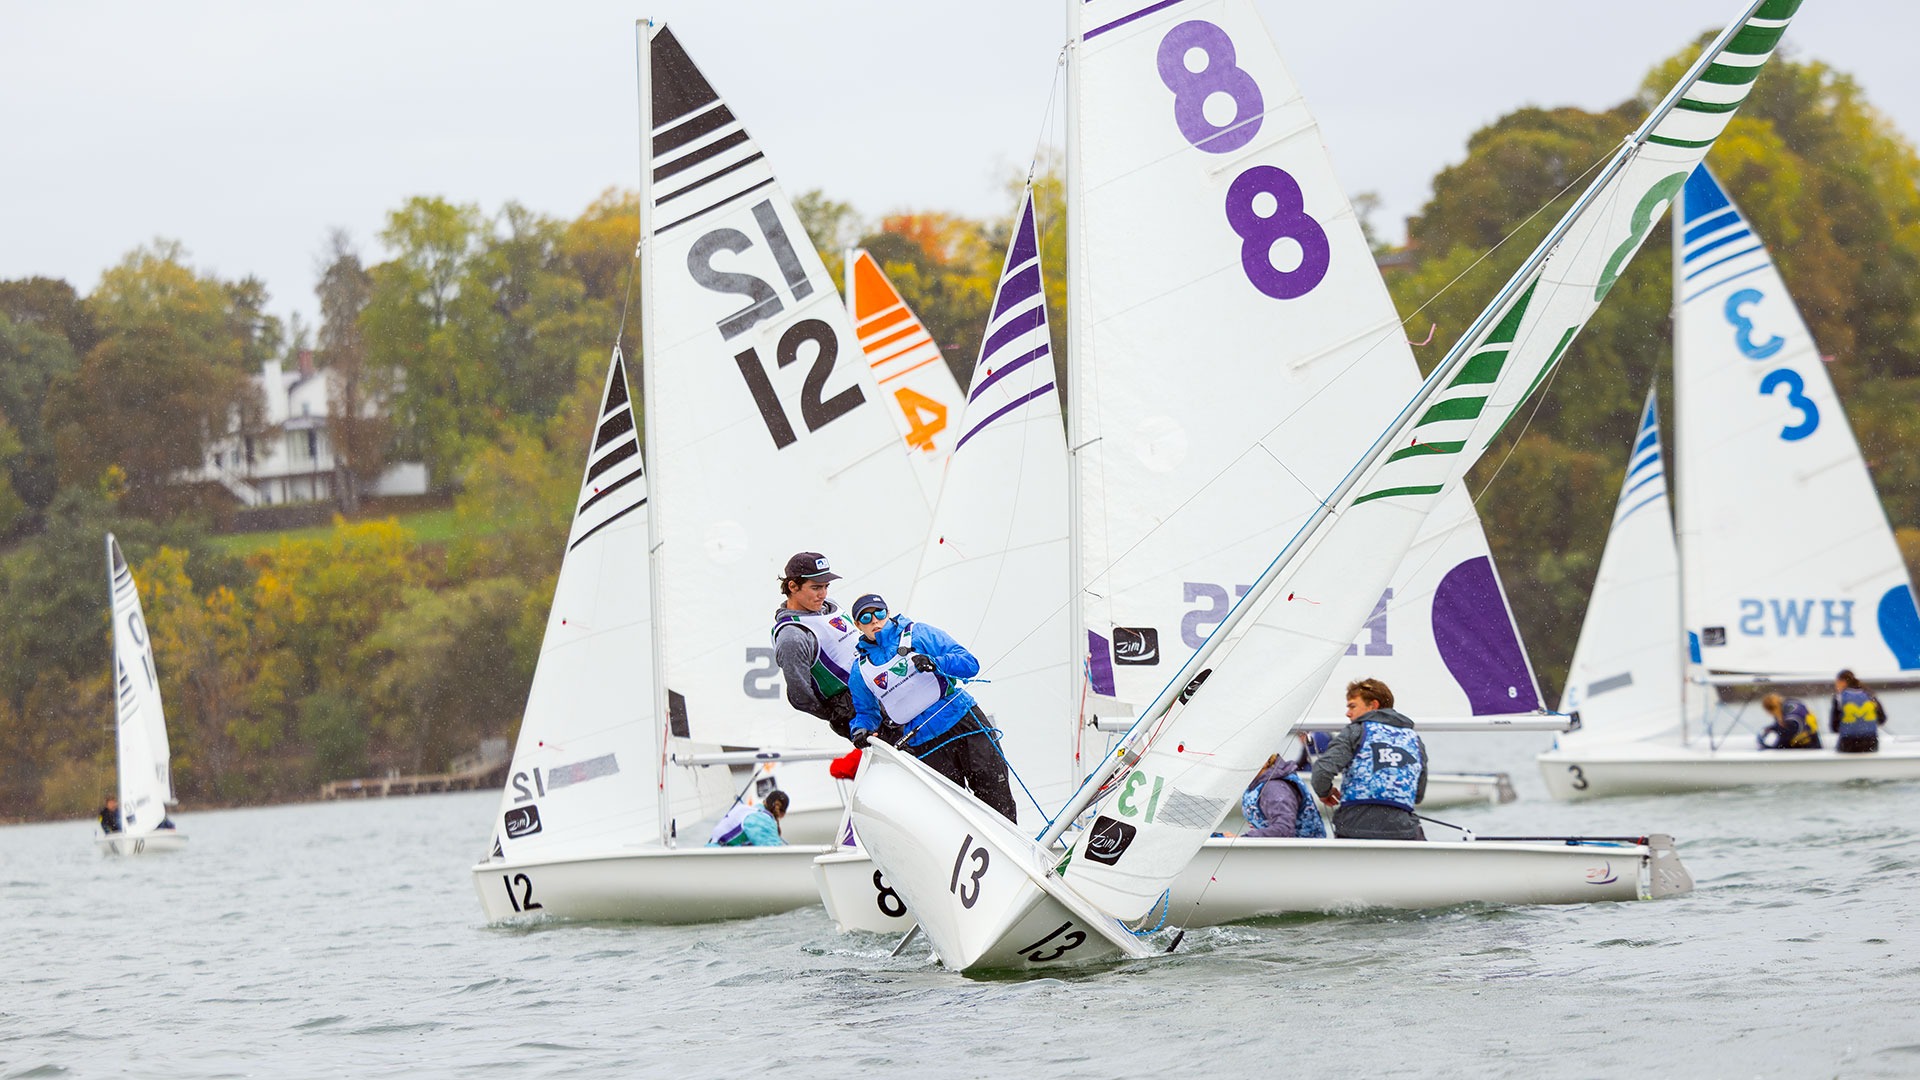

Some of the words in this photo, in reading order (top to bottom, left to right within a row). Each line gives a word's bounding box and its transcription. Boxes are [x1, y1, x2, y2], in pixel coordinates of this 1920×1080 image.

[1225, 164, 1331, 300] 8
[734, 318, 867, 451] 12
[1759, 368, 1820, 442] 3
[1508, 686, 1518, 699] 8
[1842, 700, 1877, 723] M
[1569, 765, 1589, 791] 3
[949, 833, 990, 909] 13
[503, 873, 544, 913] 12
[1016, 920, 1087, 962] 13
